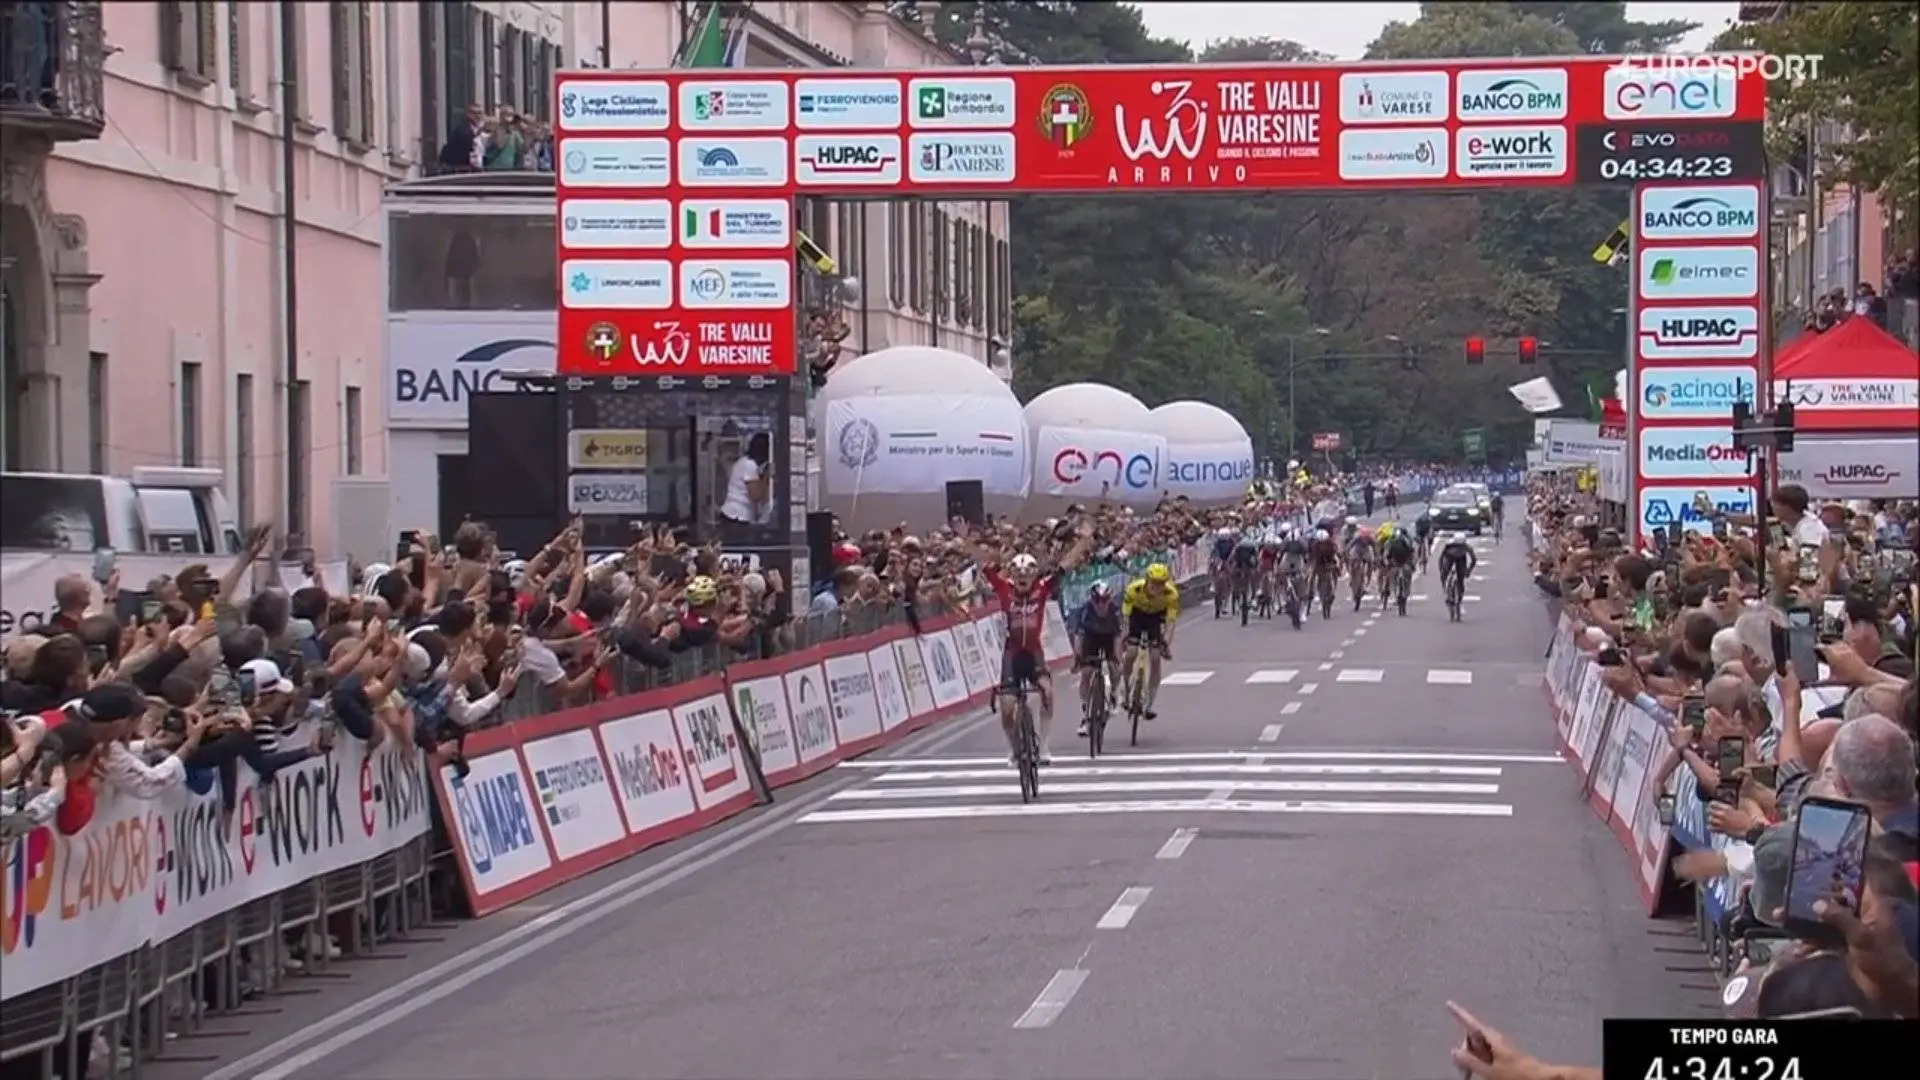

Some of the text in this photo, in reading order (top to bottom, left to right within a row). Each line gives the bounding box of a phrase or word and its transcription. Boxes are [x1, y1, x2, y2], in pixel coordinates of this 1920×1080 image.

[948, 91, 992, 103] Regione
[1217, 81, 1320, 111] TRE VALLI
[1462, 93, 1561, 111] BANCO BPM
[1617, 74, 1722, 112] enel
[948, 103, 1005, 113] Lombardia
[1382, 102, 1432, 114] VARESE
[1217, 113, 1320, 144] VARESINE
[1468, 131, 1553, 156] e-work
[818, 146, 879, 164] HUPAC
[1108, 166, 1246, 183] ARRIVO
[1601, 157, 1732, 179] 04:34:23
[1645, 210, 1754, 227] BANCO BPM
[1679, 265, 1748, 279] elmec
[698, 323, 772, 342] TRE VALLI
[1662, 319, 1737, 338] HUPAC
[698, 345, 772, 365] VARESINE
[396, 369, 530, 402] BANC
[1648, 444, 1746, 461] MediaOne
[1054, 446, 1160, 490] enel
[1168, 459, 1251, 482] acinque
[1830, 465, 1885, 479] HUPAC
[240, 757, 344, 876] e-work
[475, 771, 535, 858] MAPEI
